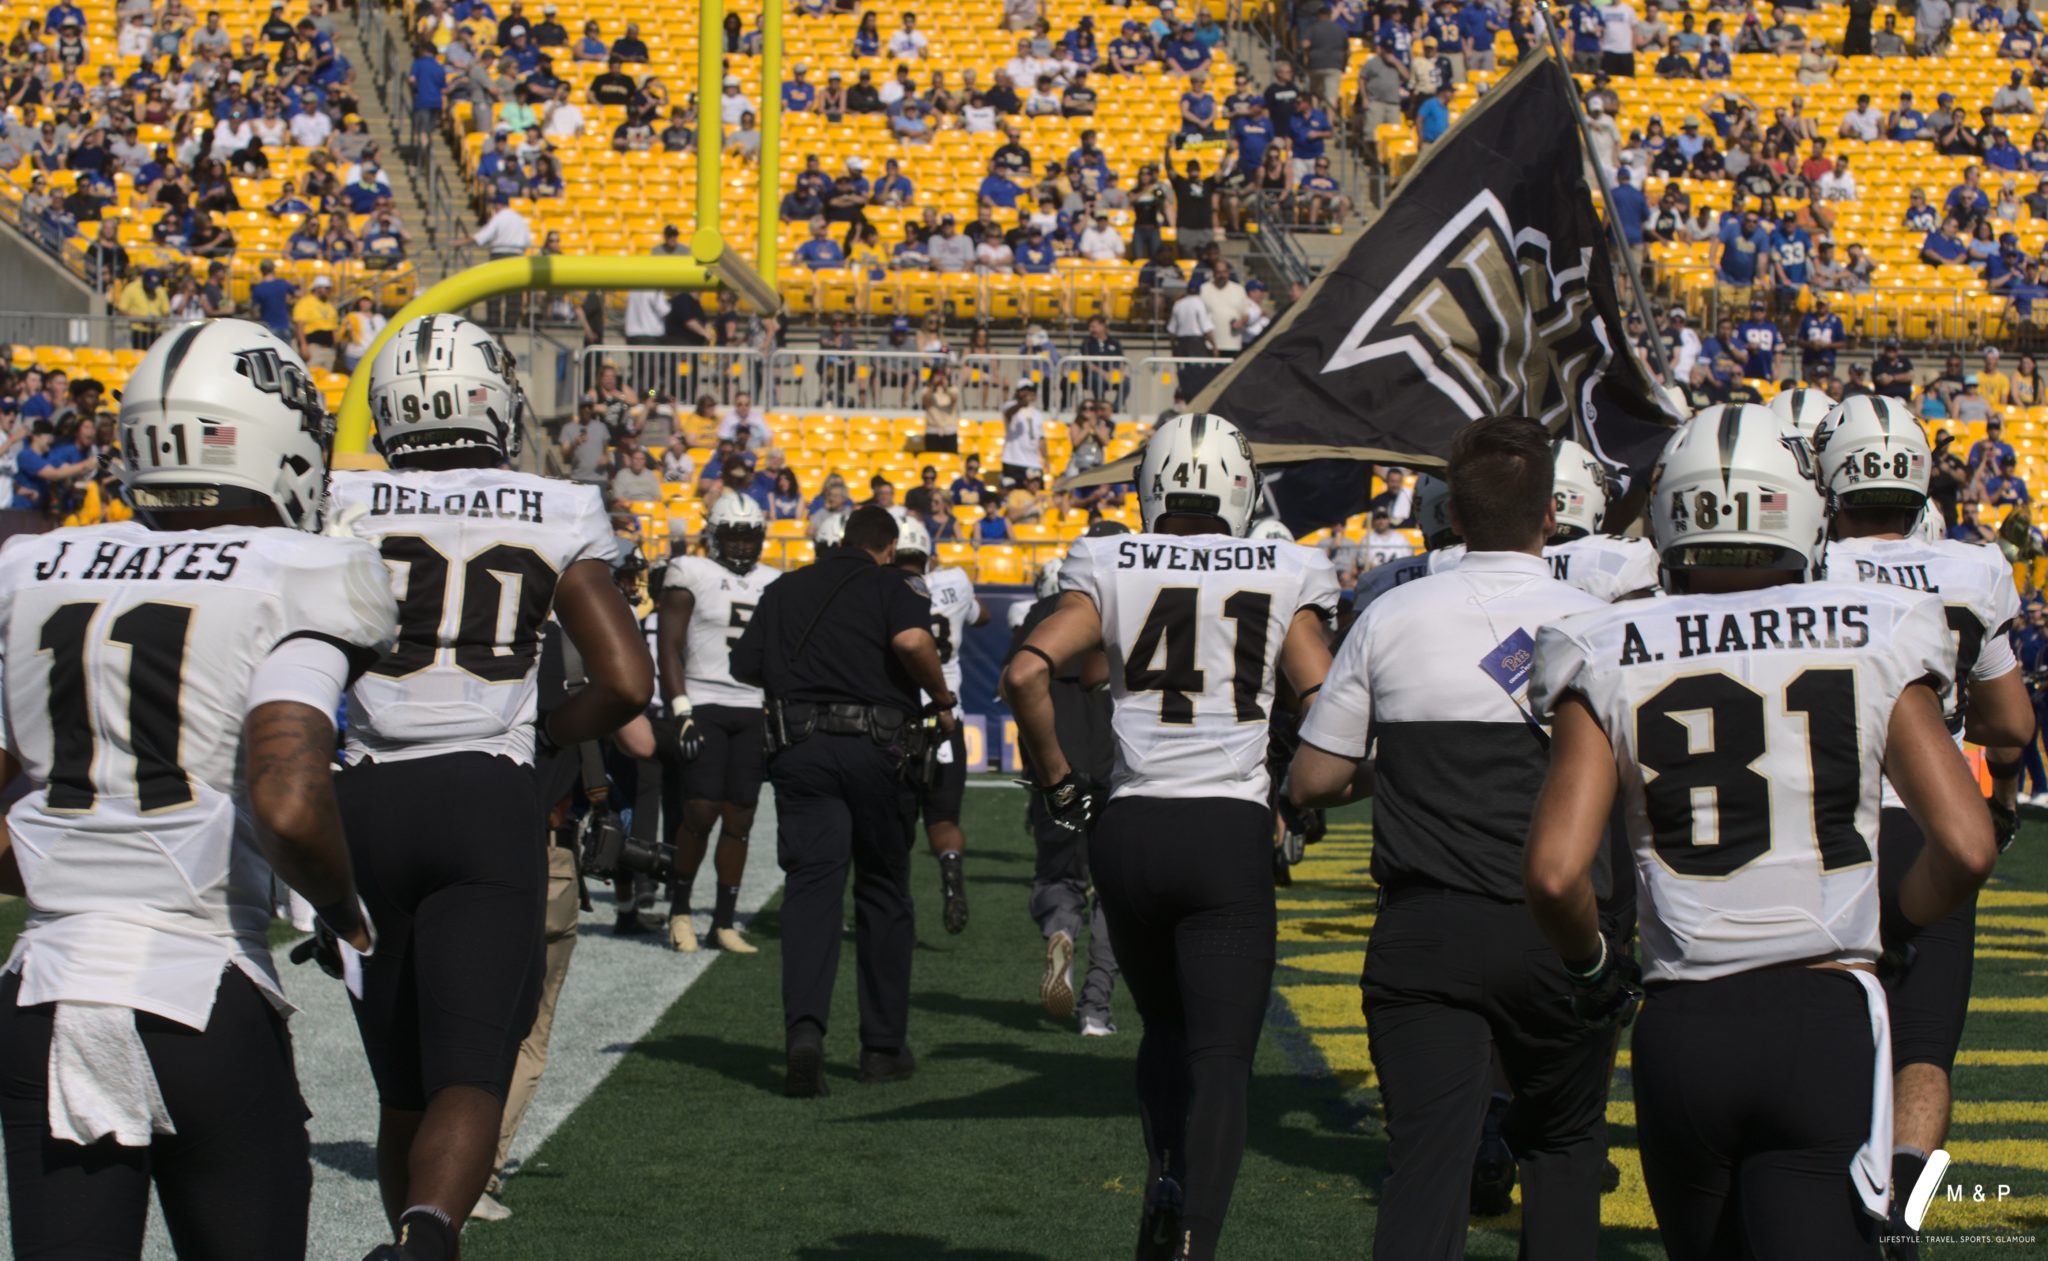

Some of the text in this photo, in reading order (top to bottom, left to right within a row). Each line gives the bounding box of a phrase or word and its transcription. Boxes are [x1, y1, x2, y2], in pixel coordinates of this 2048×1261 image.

[1172, 462, 1208, 489] 41
[371, 483, 543, 523] DELOACH
[35, 540, 250, 581] J. HAYES
[1118, 541, 1278, 572] SWENSON
[1855, 559, 1940, 594] PAUL
[1618, 604, 1870, 666] A. HARRIS
[1124, 585, 1274, 727] 41
[35, 600, 200, 817] 11
[1632, 664, 1874, 882] 81
